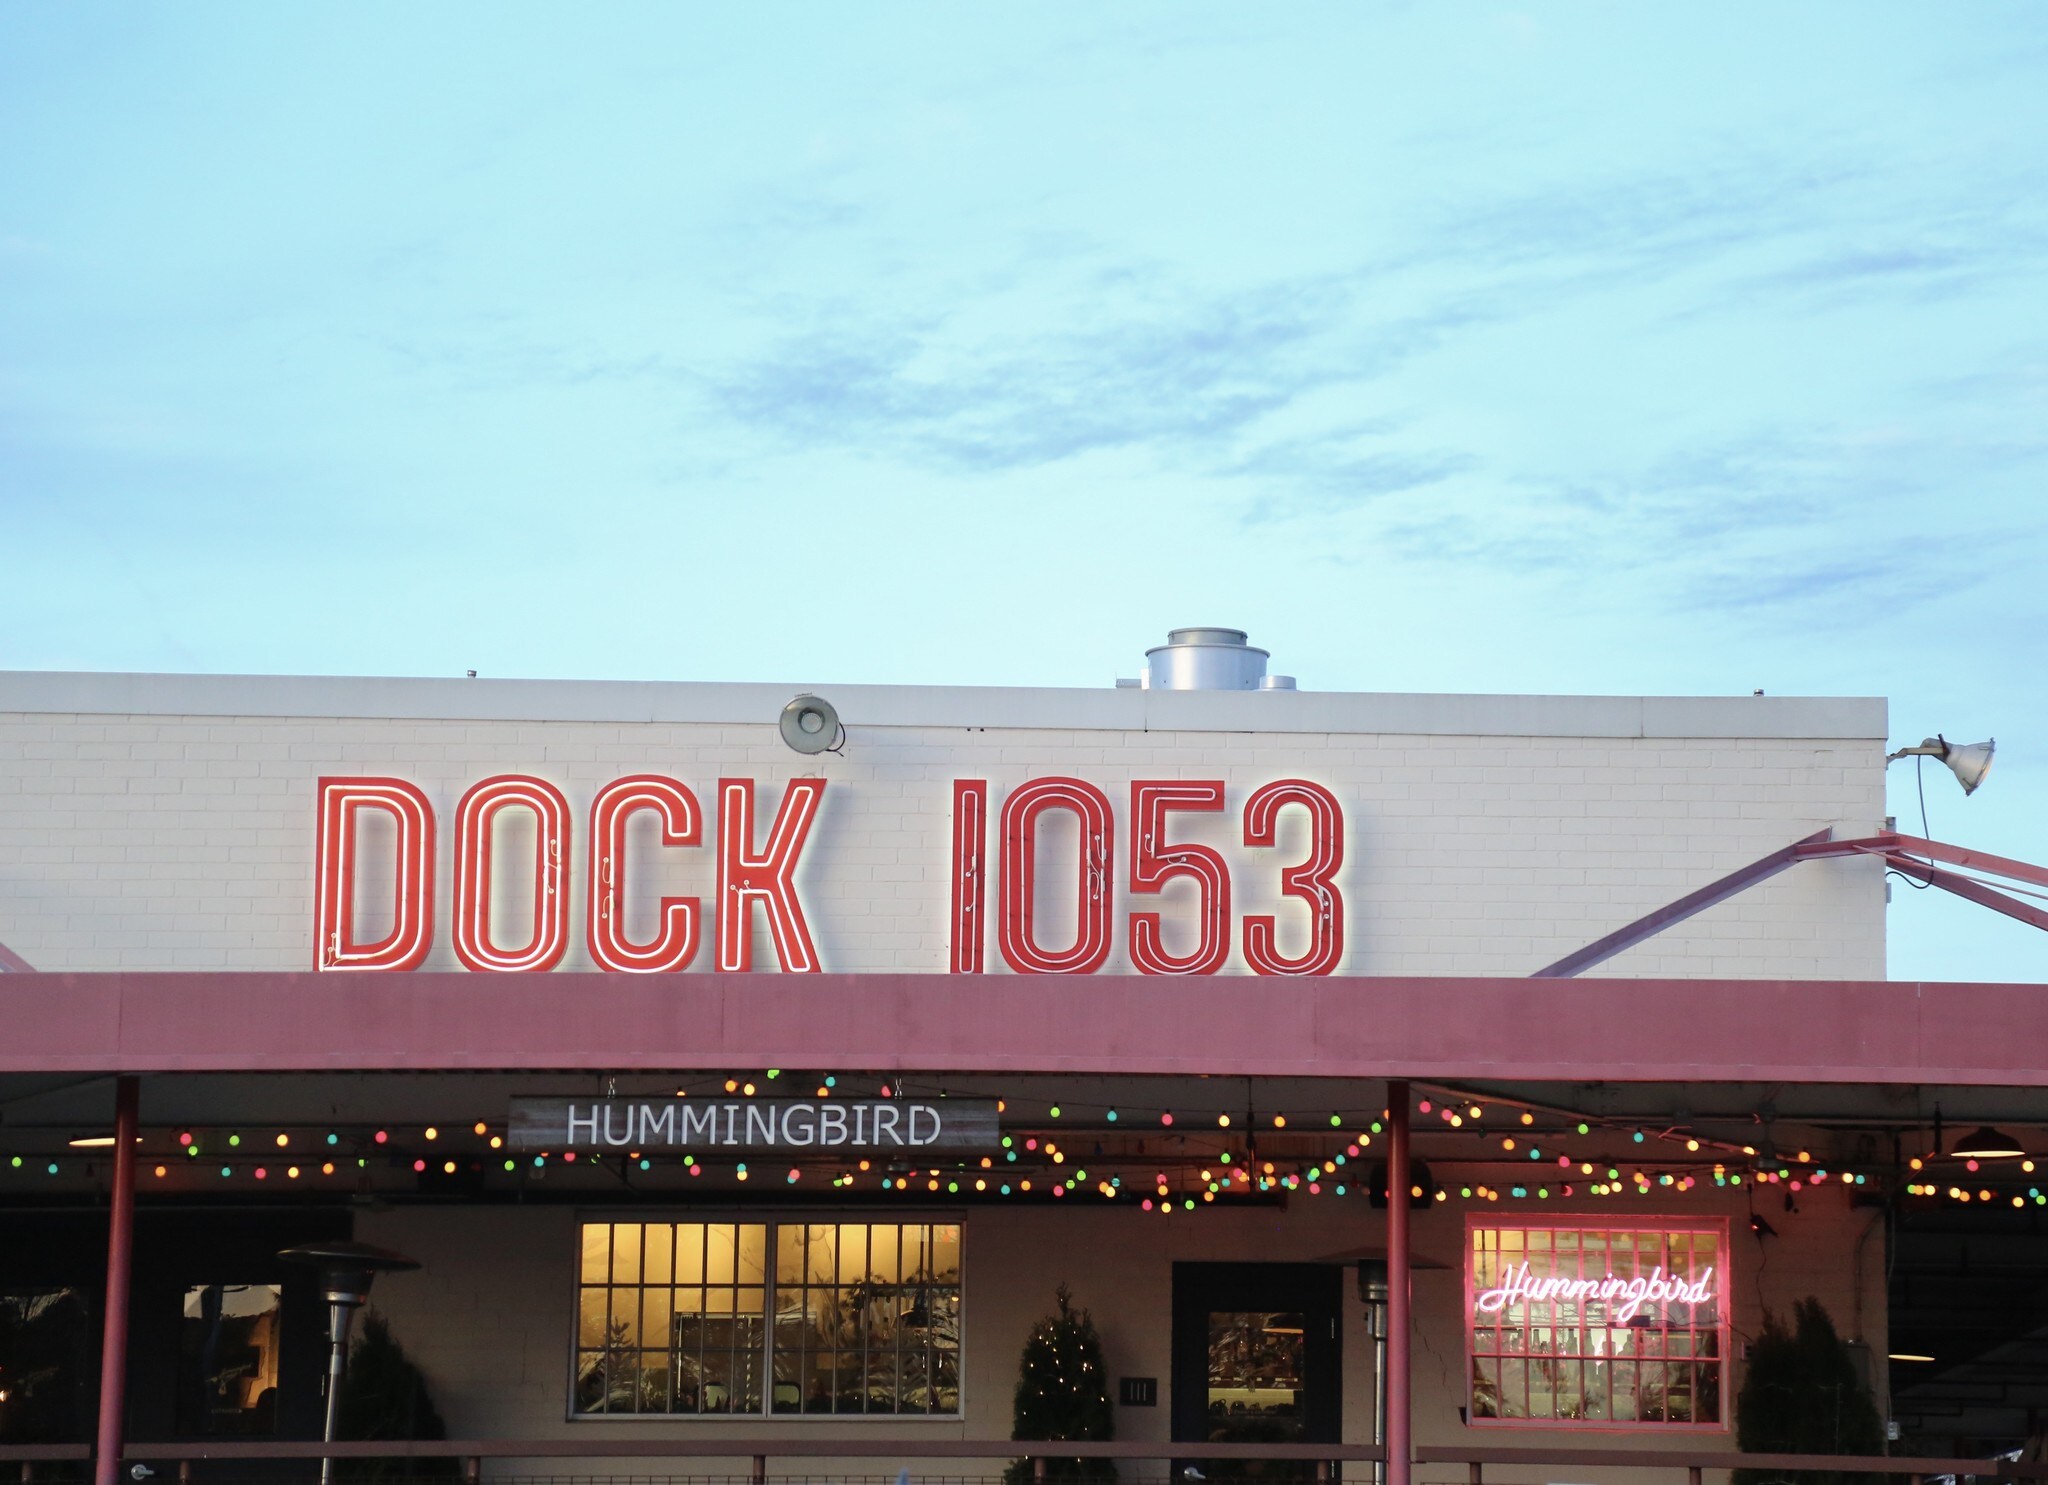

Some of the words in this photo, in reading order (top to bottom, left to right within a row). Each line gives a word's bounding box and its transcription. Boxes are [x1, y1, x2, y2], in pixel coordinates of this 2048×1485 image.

[312, 774, 828, 973] DOCK
[950, 776, 1344, 976] 1053
[566, 1103, 942, 1146] HUMMINGBIRD
[1479, 1260, 1713, 1322] Hummingbird
